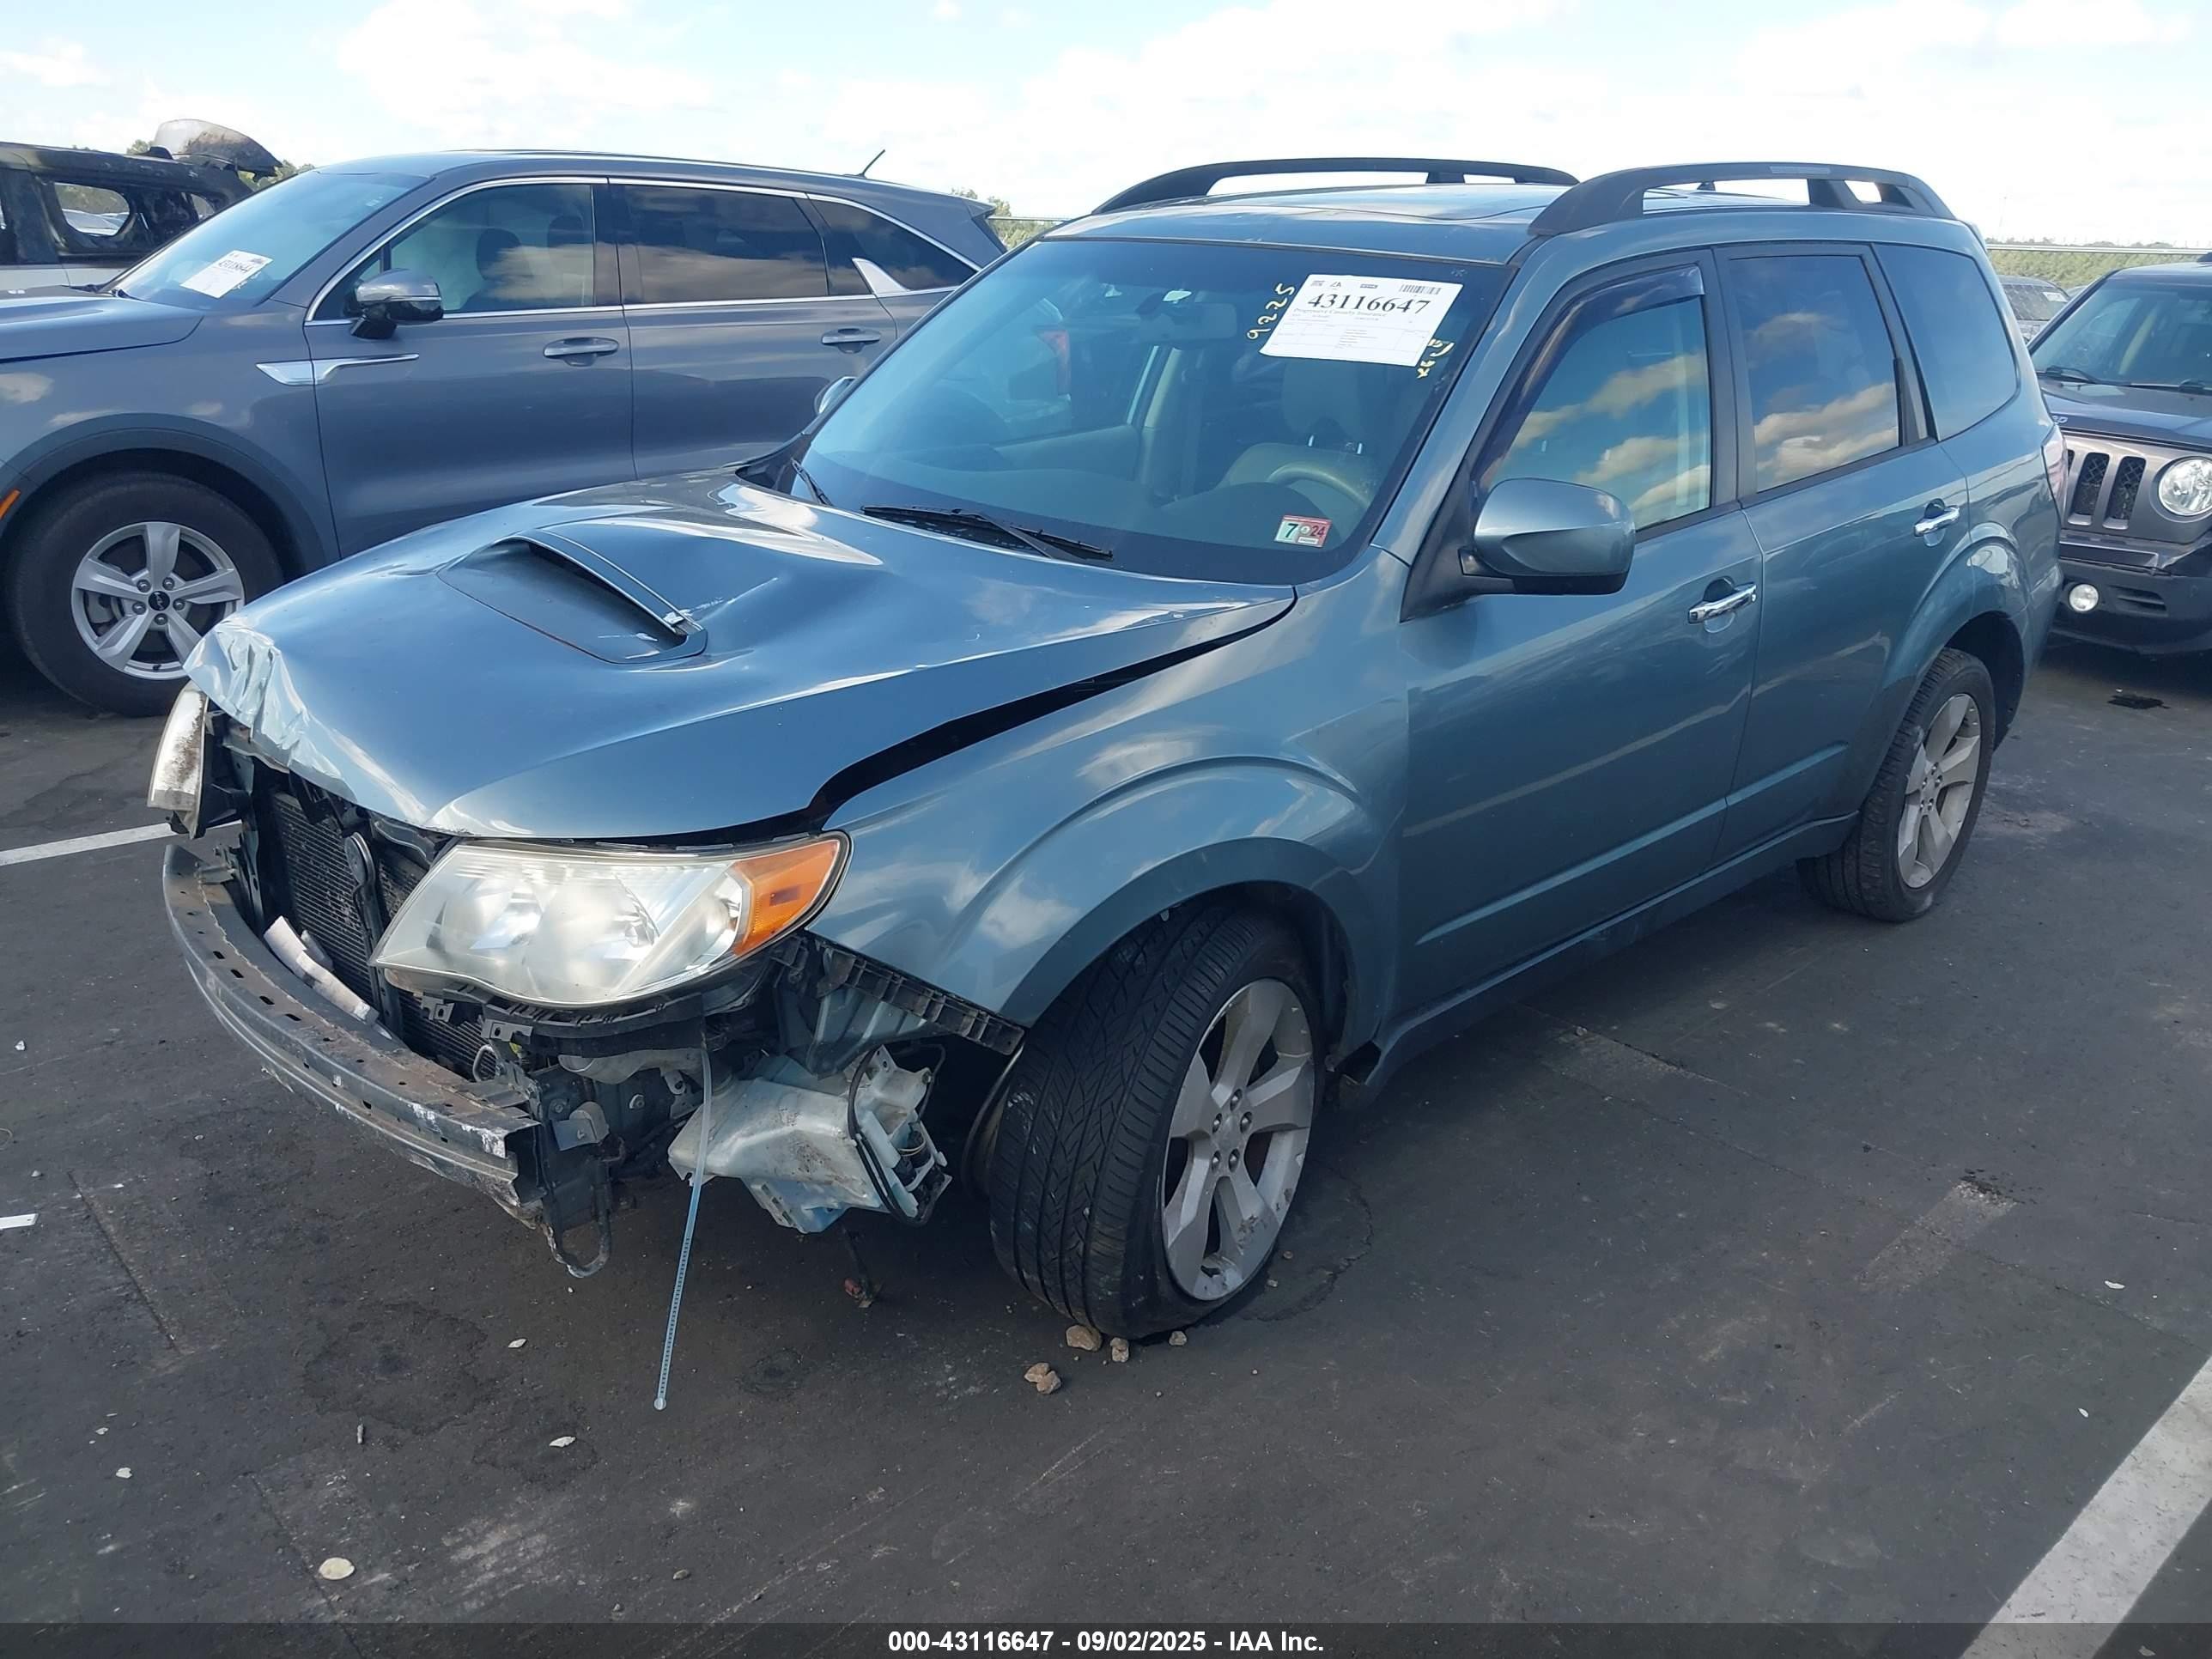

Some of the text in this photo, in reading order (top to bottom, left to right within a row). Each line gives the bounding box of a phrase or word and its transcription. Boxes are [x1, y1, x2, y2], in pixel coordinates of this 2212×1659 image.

[1247, 283, 1295, 339] 9225
[1307, 293, 1431, 314] 43116647
[1285, 523, 1326, 538] 7 24
